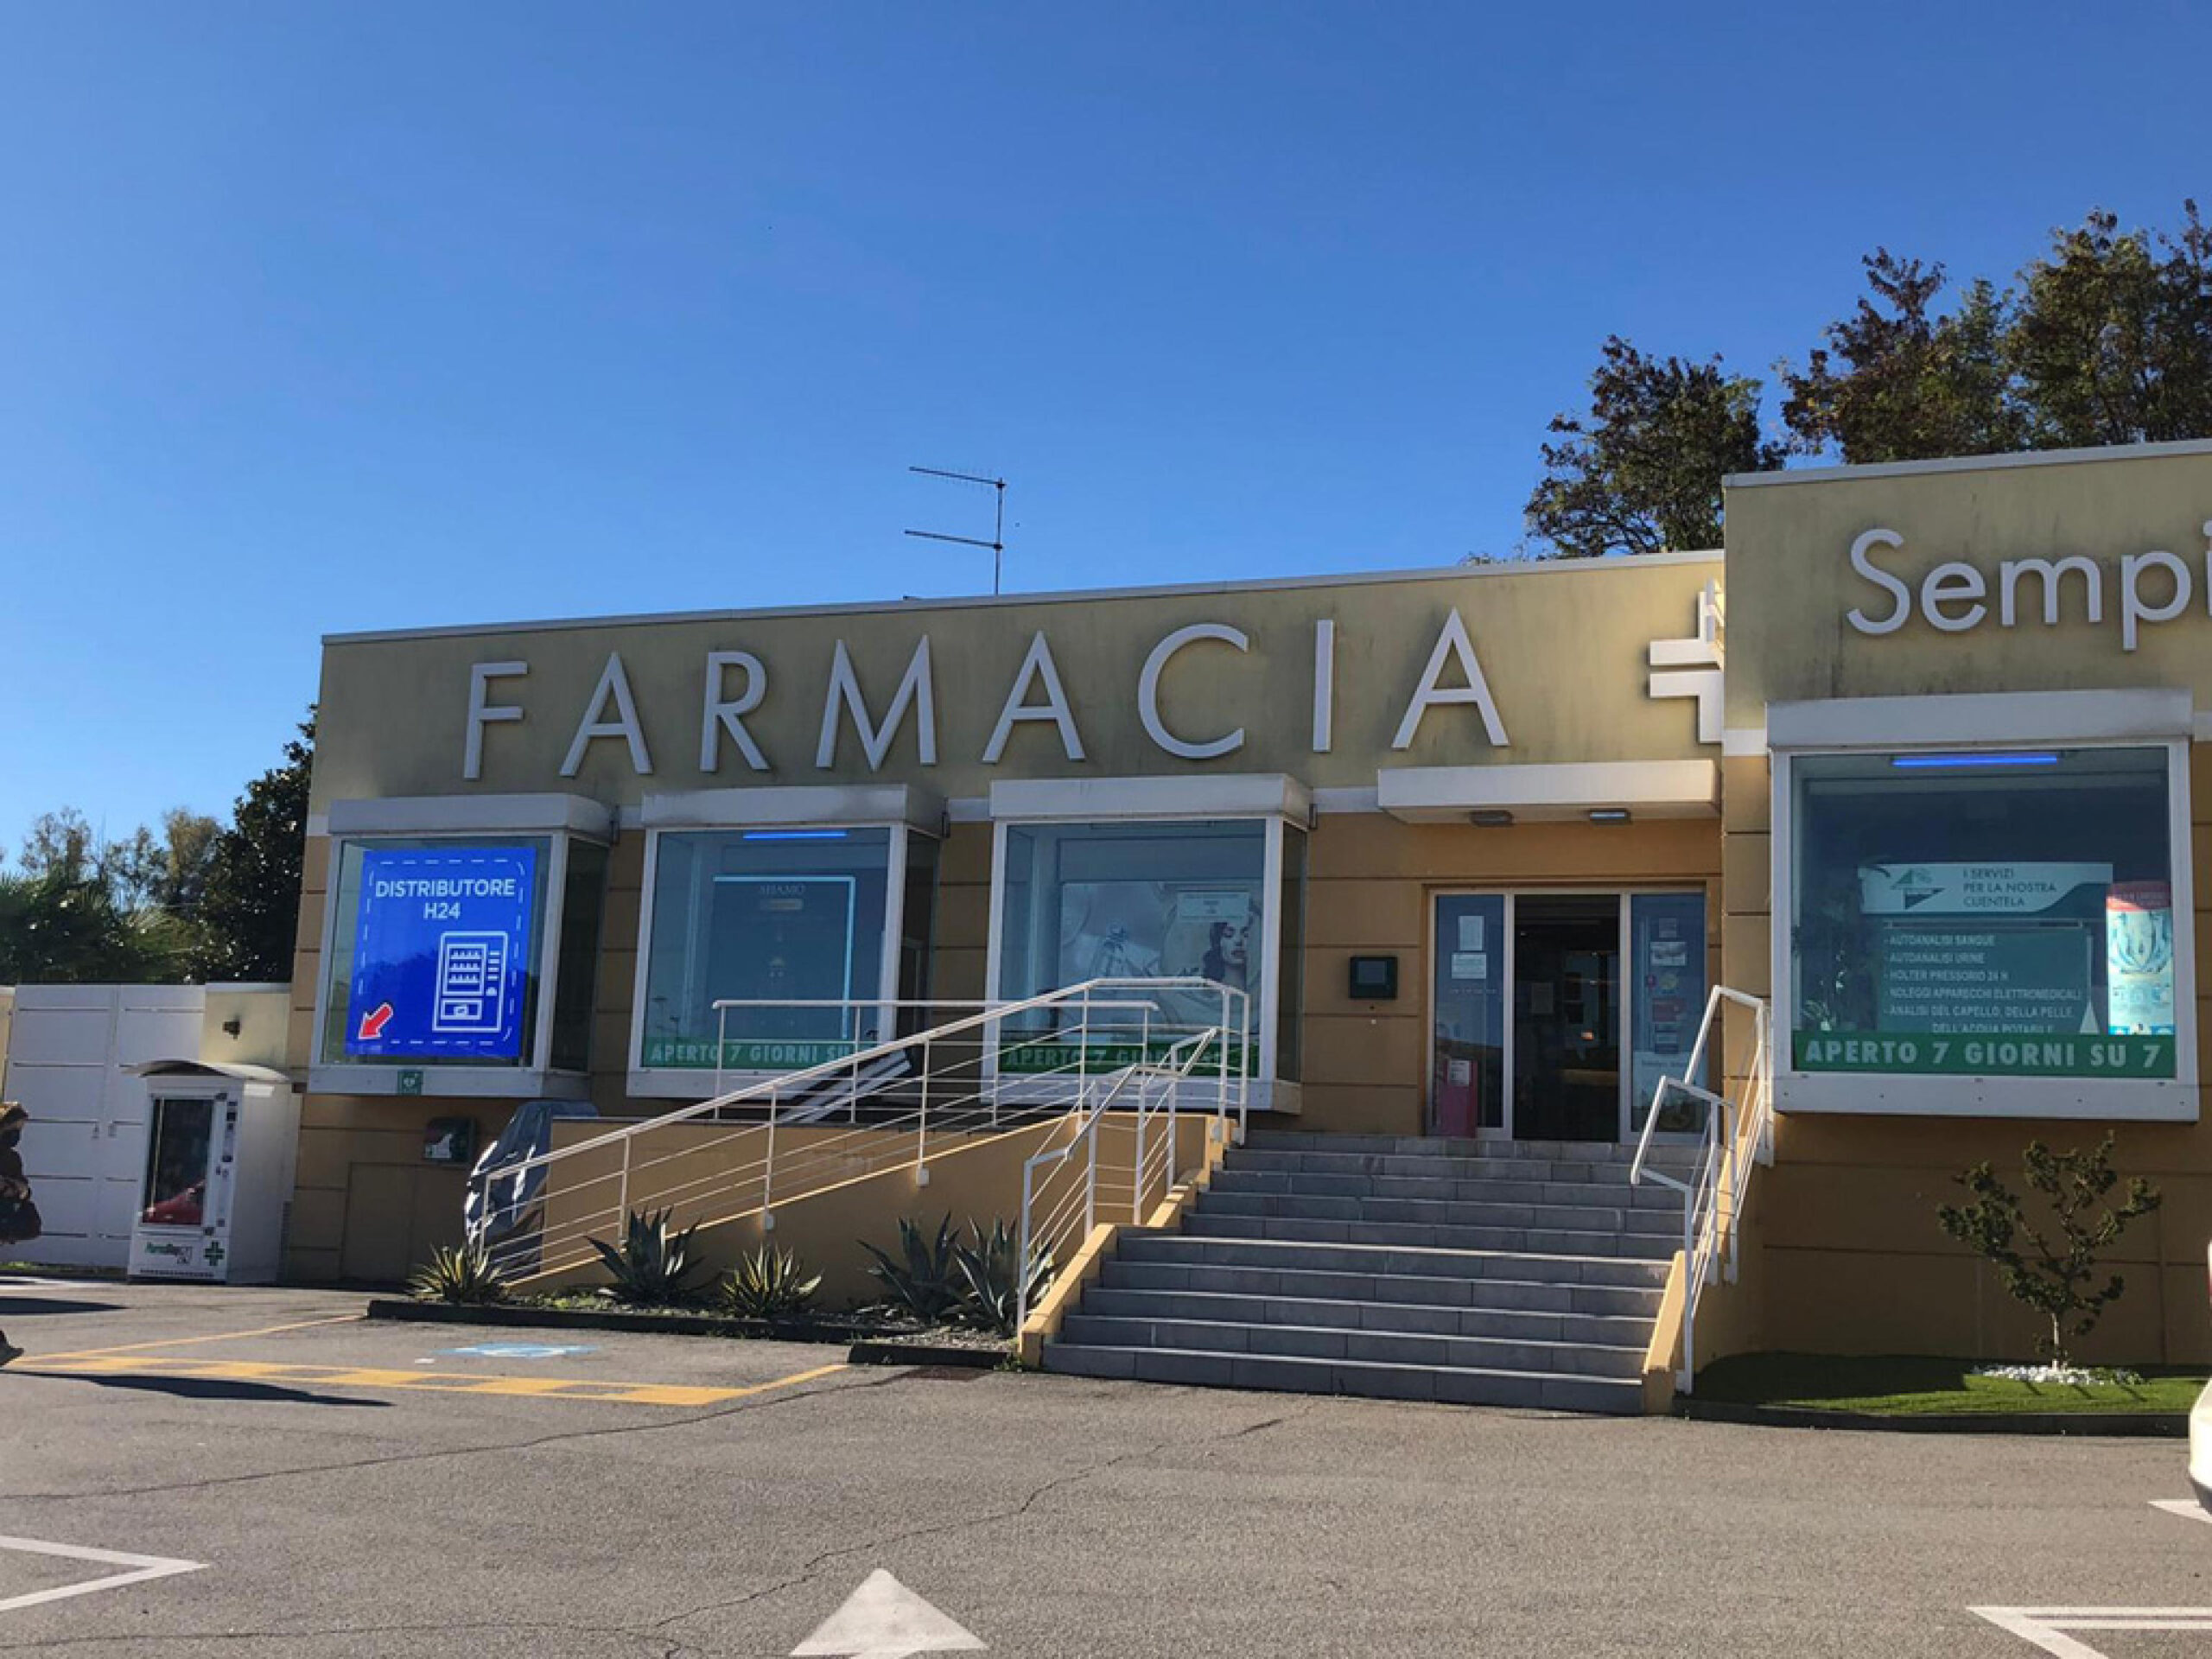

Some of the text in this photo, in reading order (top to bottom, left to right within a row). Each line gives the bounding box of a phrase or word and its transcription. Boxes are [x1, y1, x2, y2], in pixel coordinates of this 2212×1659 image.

[463, 607, 1510, 780] FARMACIA
[375, 878, 516, 898] DISTRIBUTORE
[1963, 882, 2057, 893] PER LA NOSTRA
[423, 902, 461, 919] H24
[650, 1043, 720, 1062] APERTO
[749, 1044, 817, 1063] GIORNI
[1805, 1040, 2161, 1068] APERTO 7 GIORNI SU 7
